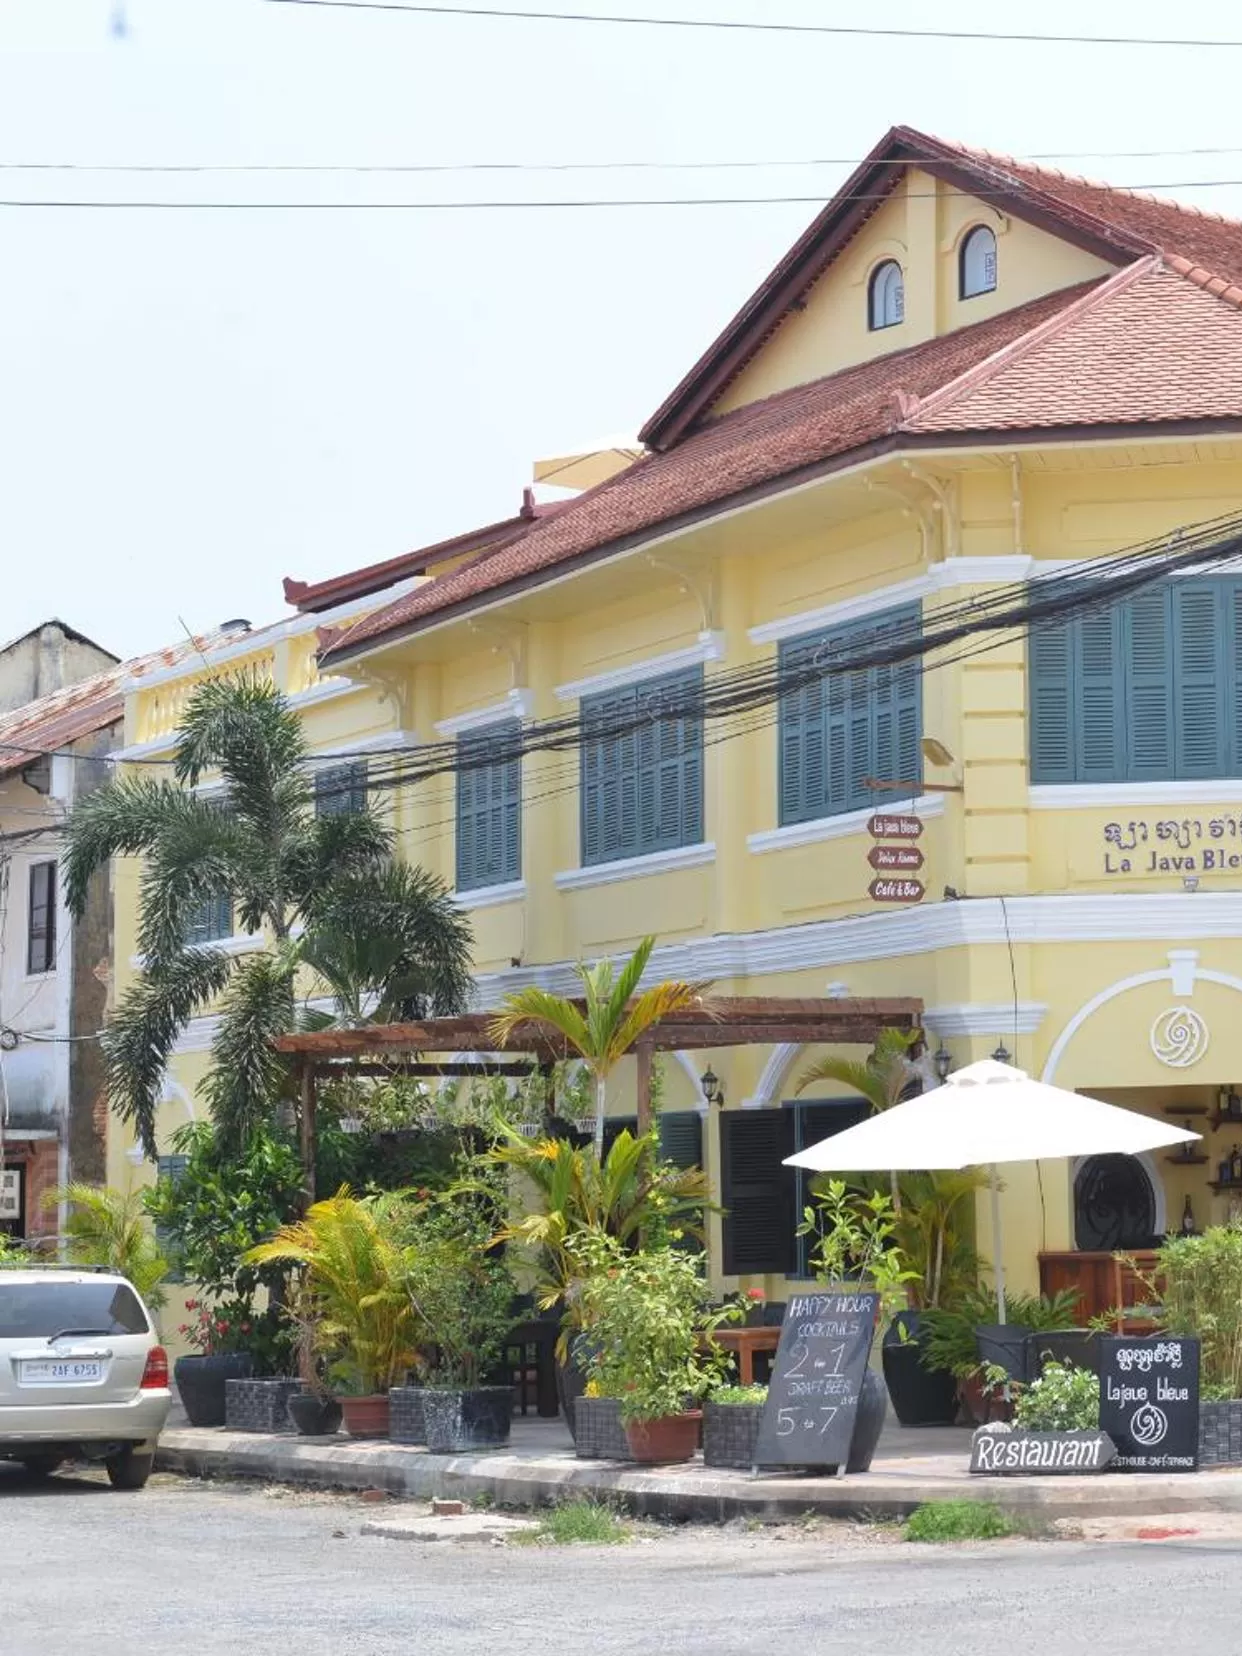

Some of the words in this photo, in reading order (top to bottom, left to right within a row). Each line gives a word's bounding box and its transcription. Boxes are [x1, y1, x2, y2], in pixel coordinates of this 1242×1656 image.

[1104, 853, 1131, 873] La
[1146, 851, 1196, 872] Java
[903, 881, 920, 897] Bar
[789, 1295, 835, 1318] HAPPY
[836, 1295, 874, 1313] HOUR
[797, 1319, 860, 1338] COCKTAILS
[784, 1343, 809, 1379] 2
[823, 1343, 846, 1378] 1
[824, 1379, 852, 1395] BEER
[1156, 1376, 1189, 1400] bleue
[776, 1407, 802, 1436] 5
[820, 1407, 838, 1435] 7
[977, 1436, 1104, 1469] Restaurant
